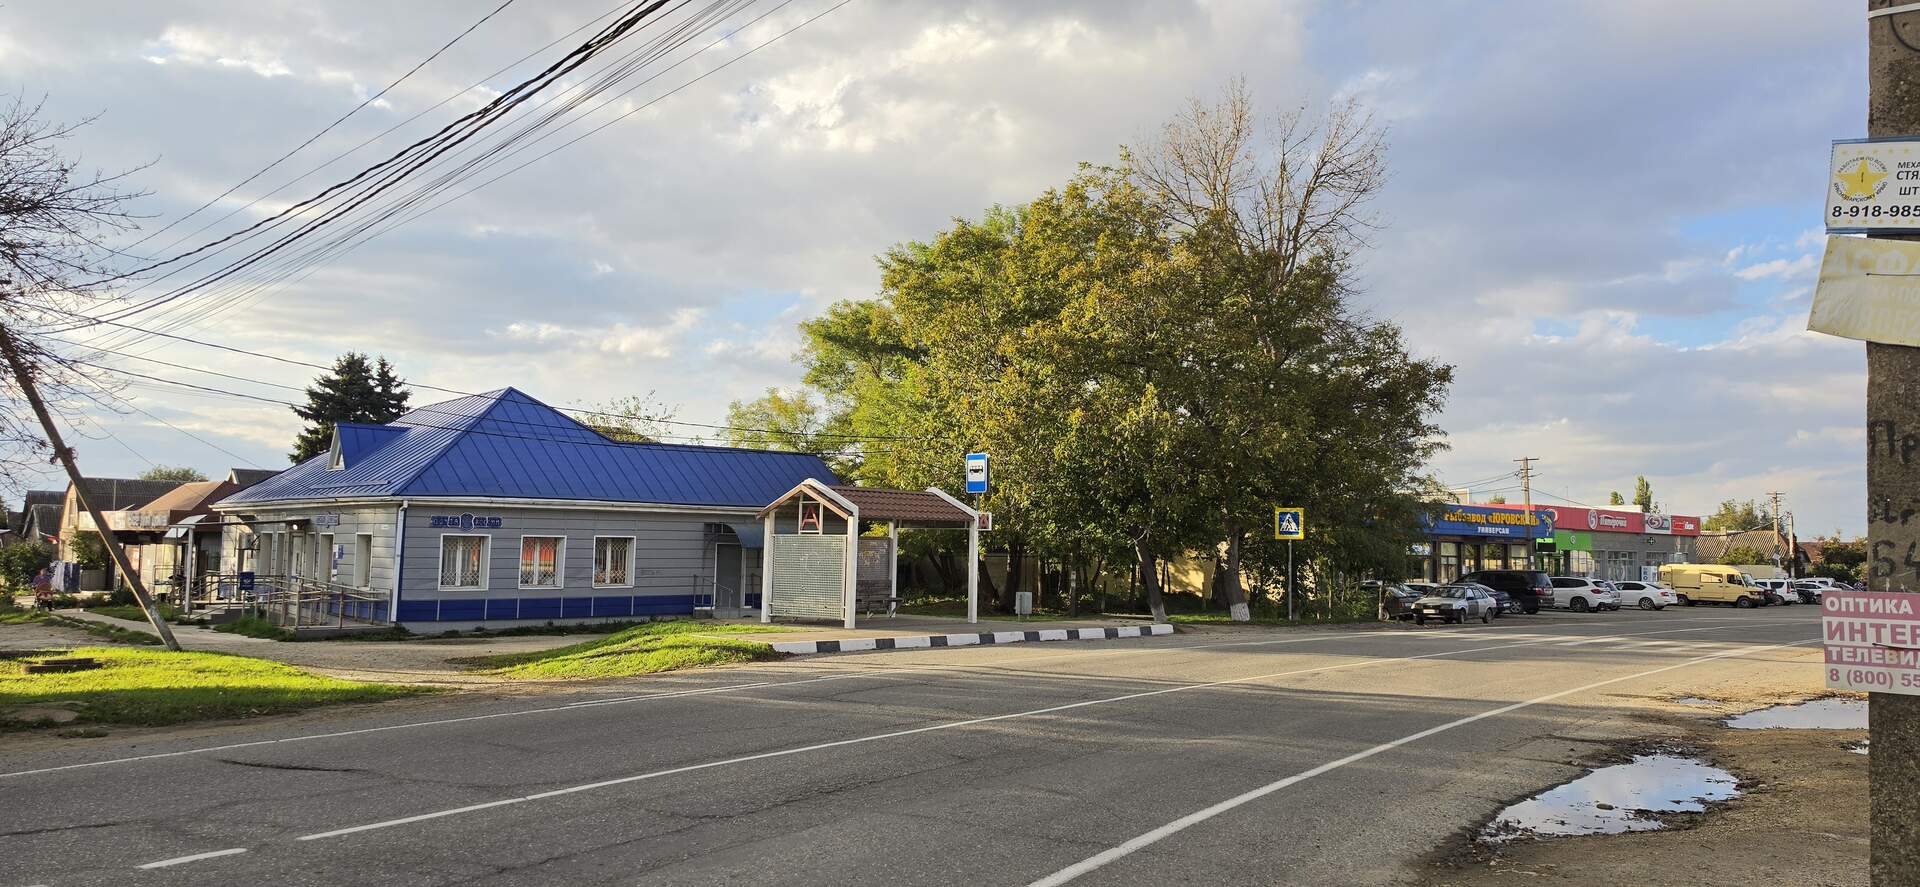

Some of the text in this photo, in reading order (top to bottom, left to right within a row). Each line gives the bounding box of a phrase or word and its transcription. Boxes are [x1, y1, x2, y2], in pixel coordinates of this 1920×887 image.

[1896, 170, 1920, 181] СТЯ
[1832, 205, 1920, 218] 8-918-985
[1488, 512, 1540, 526] «ЮРОВСКЙ»
[1825, 597, 1913, 614] ОПТИКА
[1829, 668, 1839, 681] 8
[1846, 669, 1894, 689] (800)
